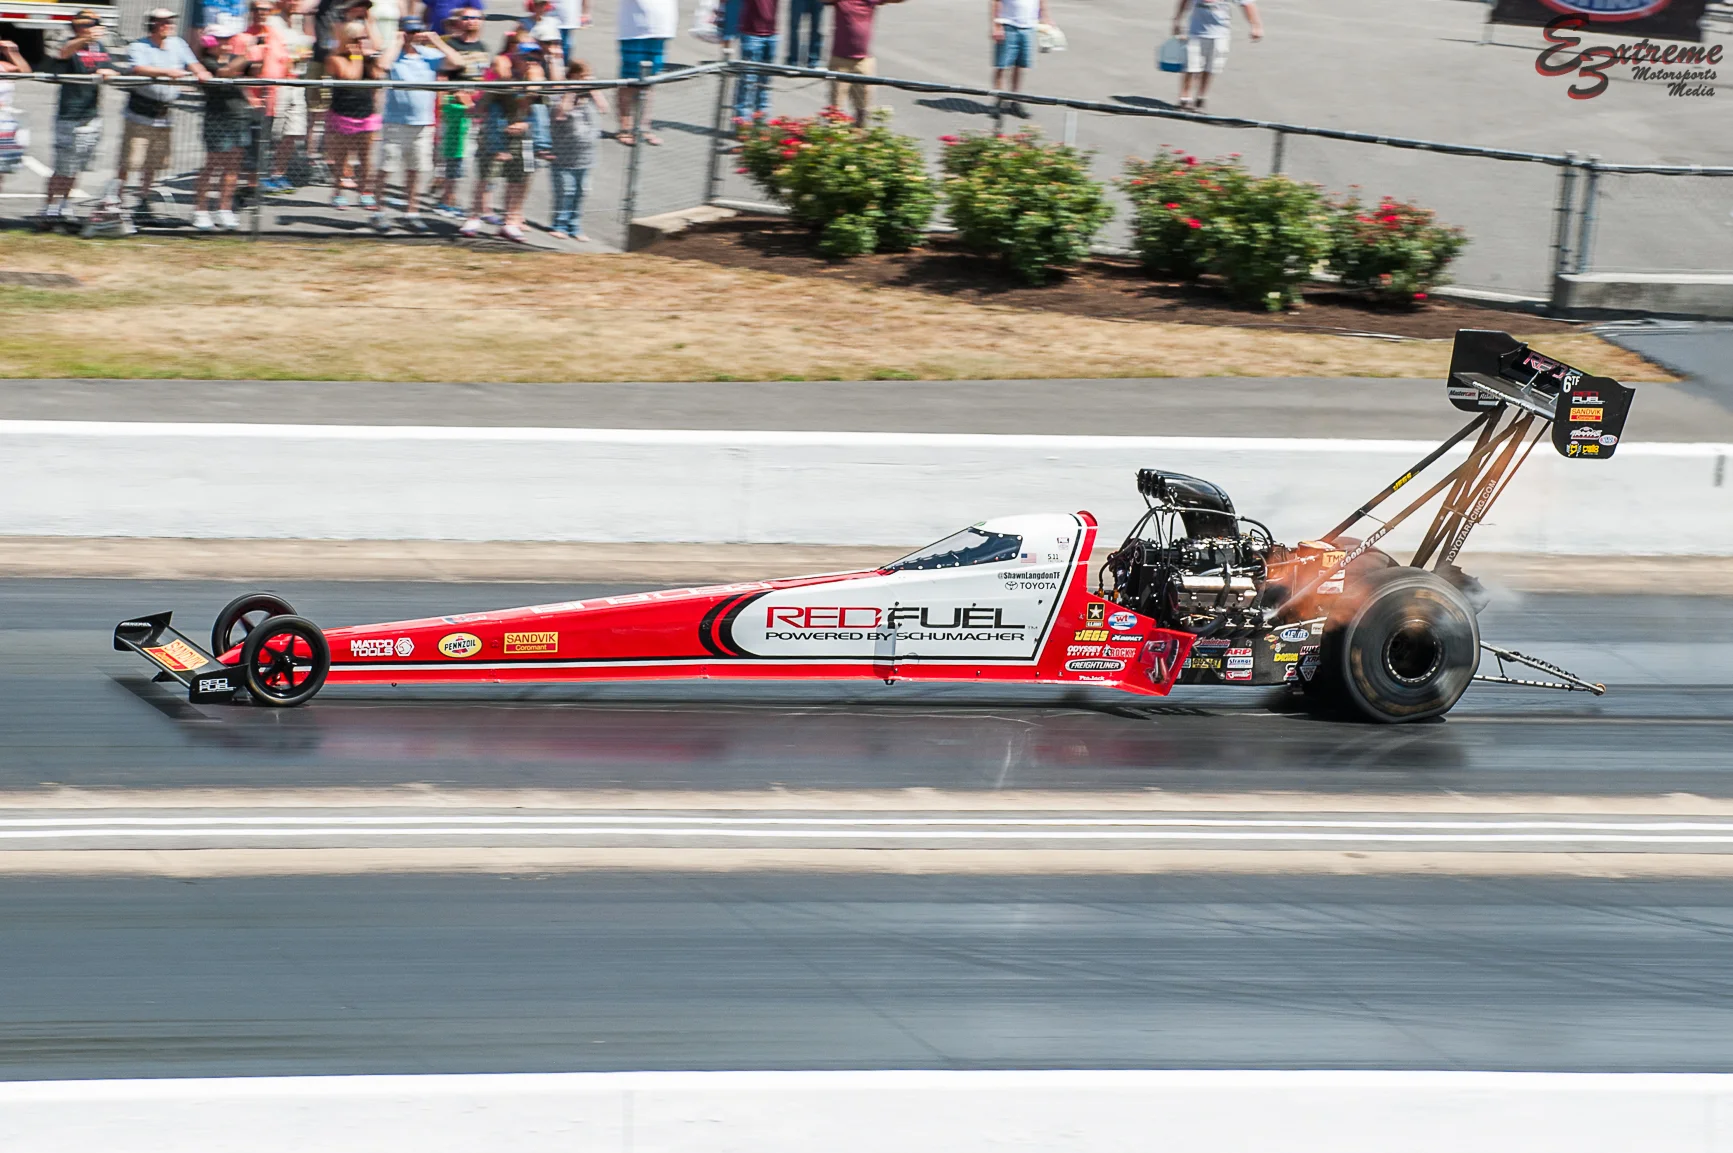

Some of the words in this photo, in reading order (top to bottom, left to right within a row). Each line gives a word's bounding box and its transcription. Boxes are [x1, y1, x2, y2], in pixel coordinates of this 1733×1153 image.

[1446, 479, 1497, 563] TOYOTARACING.COM
[998, 571, 1060, 580] @ShawnLangdonTF
[1020, 582, 1057, 590] TOYOTA
[766, 606, 883, 628] RED
[886, 607, 1026, 629] FUEL
[1116, 615, 1129, 623] wt
[507, 634, 556, 644] SANDVIK
[766, 632, 863, 641] POWERED
[866, 632, 893, 641] BY
[897, 632, 1025, 641] SCHUMACHER
[1074, 629, 1109, 641] JEGS
[350, 640, 394, 649] MATCO
[444, 639, 477, 651] PENNZOIL
[352, 647, 394, 656] TOOLS
[1111, 648, 1136, 657] ROCKY
[1070, 661, 1120, 669] FREIGHTLINER
